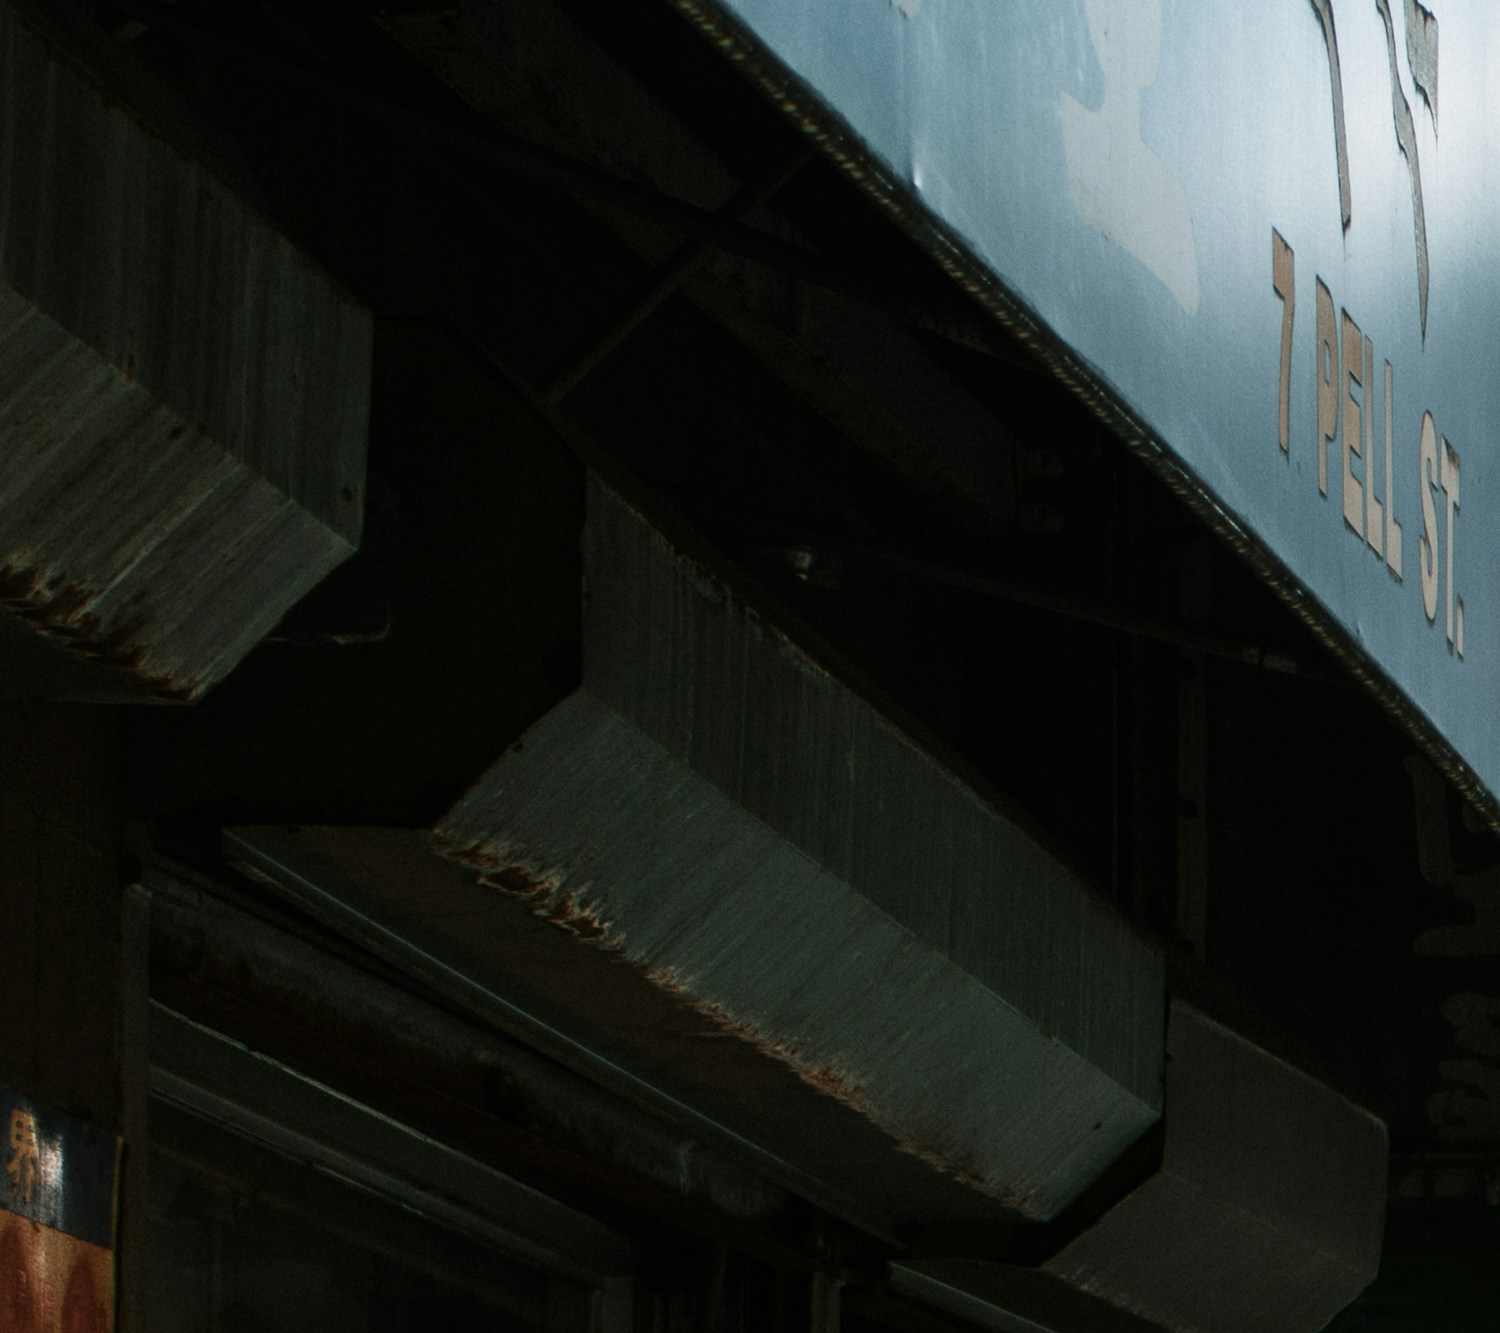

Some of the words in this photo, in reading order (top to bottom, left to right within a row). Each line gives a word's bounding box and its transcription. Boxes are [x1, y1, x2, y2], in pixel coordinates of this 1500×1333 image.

[1272, 226, 1295, 456] 7
[1315, 275, 1402, 584] PELL
[1418, 410, 1465, 660] ST.
